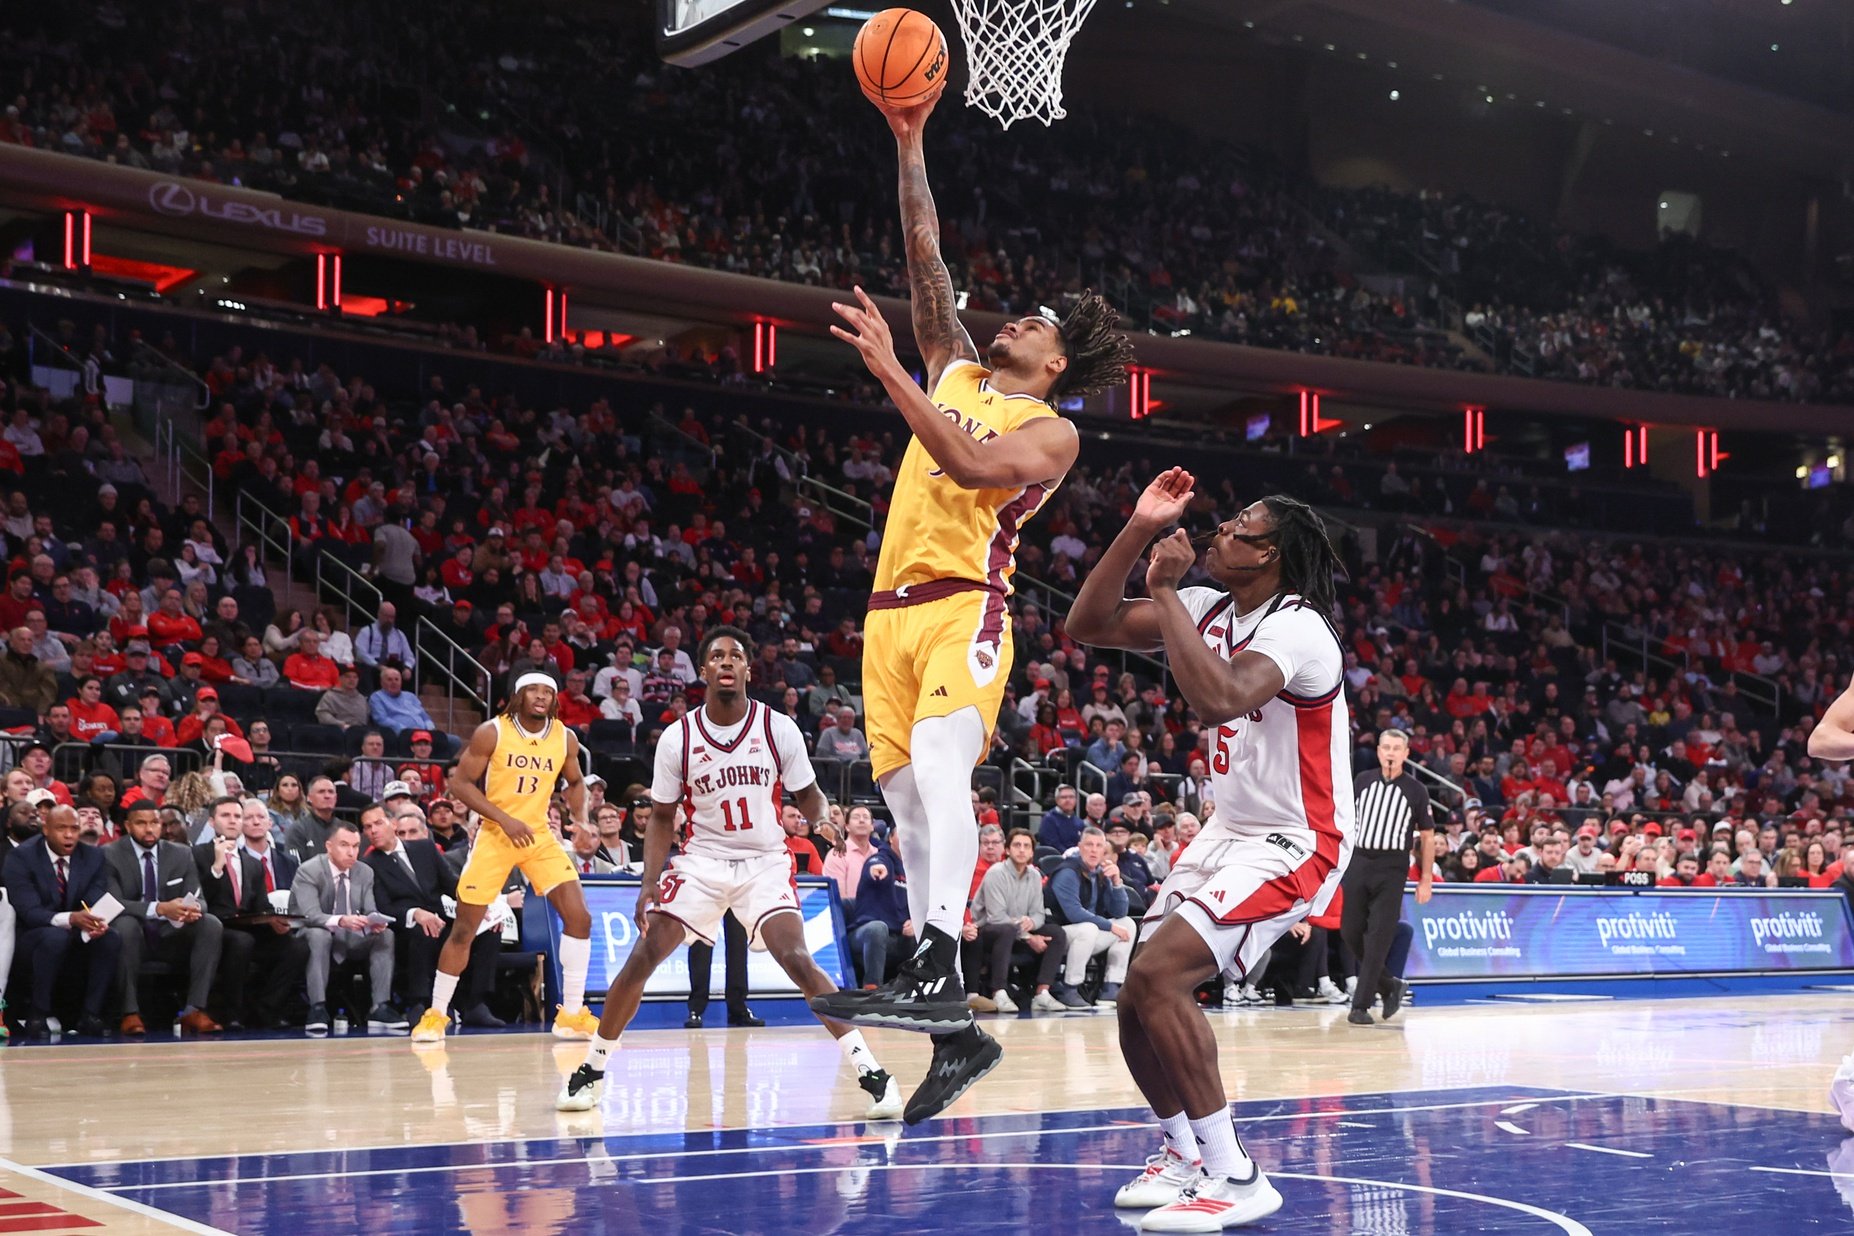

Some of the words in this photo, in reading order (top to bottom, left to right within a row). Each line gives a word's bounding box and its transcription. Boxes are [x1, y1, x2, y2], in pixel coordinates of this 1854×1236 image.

[200, 196, 327, 237] LEXUS
[366, 226, 428, 255] SUITE
[433, 237, 497, 265] LEVEL
[507, 754, 554, 772] IONA
[694, 774, 716, 795] ST.
[716, 765, 770, 788] JOHN'S
[516, 776, 539, 795] 13
[720, 797, 754, 832] 11
[1624, 872, 1649, 885] POSS
[1422, 910, 1512, 950] protiviti
[1596, 911, 1676, 948] protiviti
[1750, 911, 1823, 946] protiviti
